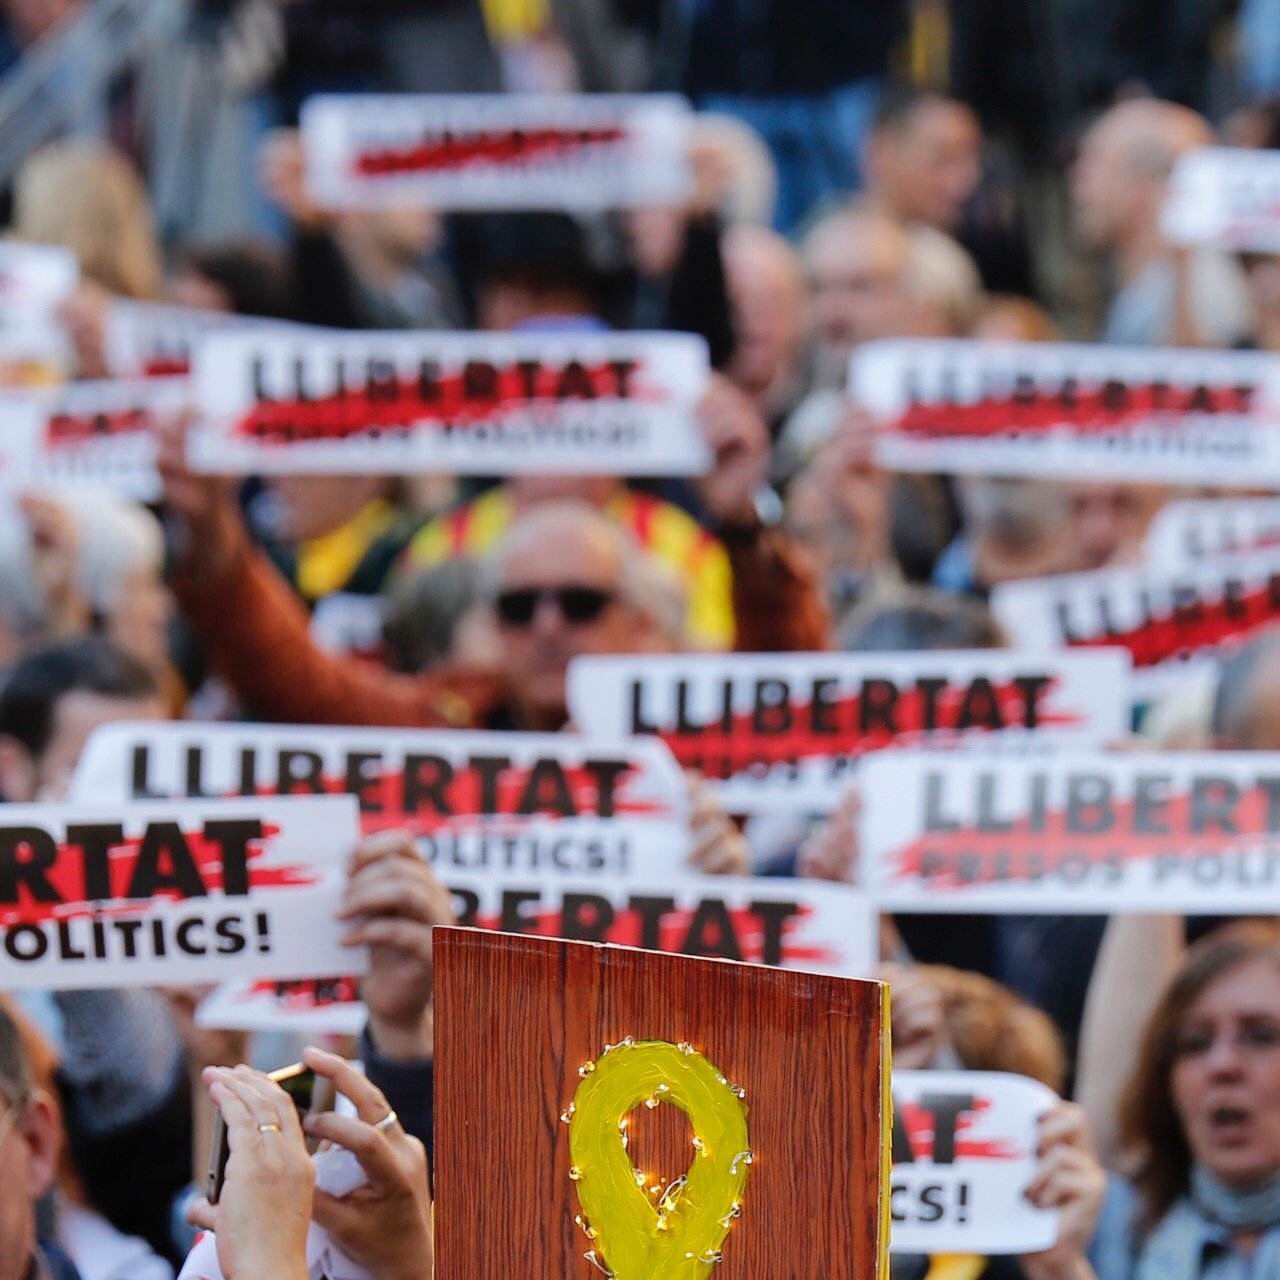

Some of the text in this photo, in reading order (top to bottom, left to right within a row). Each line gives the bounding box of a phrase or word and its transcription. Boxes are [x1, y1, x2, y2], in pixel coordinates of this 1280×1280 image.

[248, 356, 642, 400] LLIBERTAT
[632, 674, 1052, 734] LLIBERTAT
[131, 744, 634, 820] LLIBERTAT
[417, 829, 633, 873] OLÍTICS!
